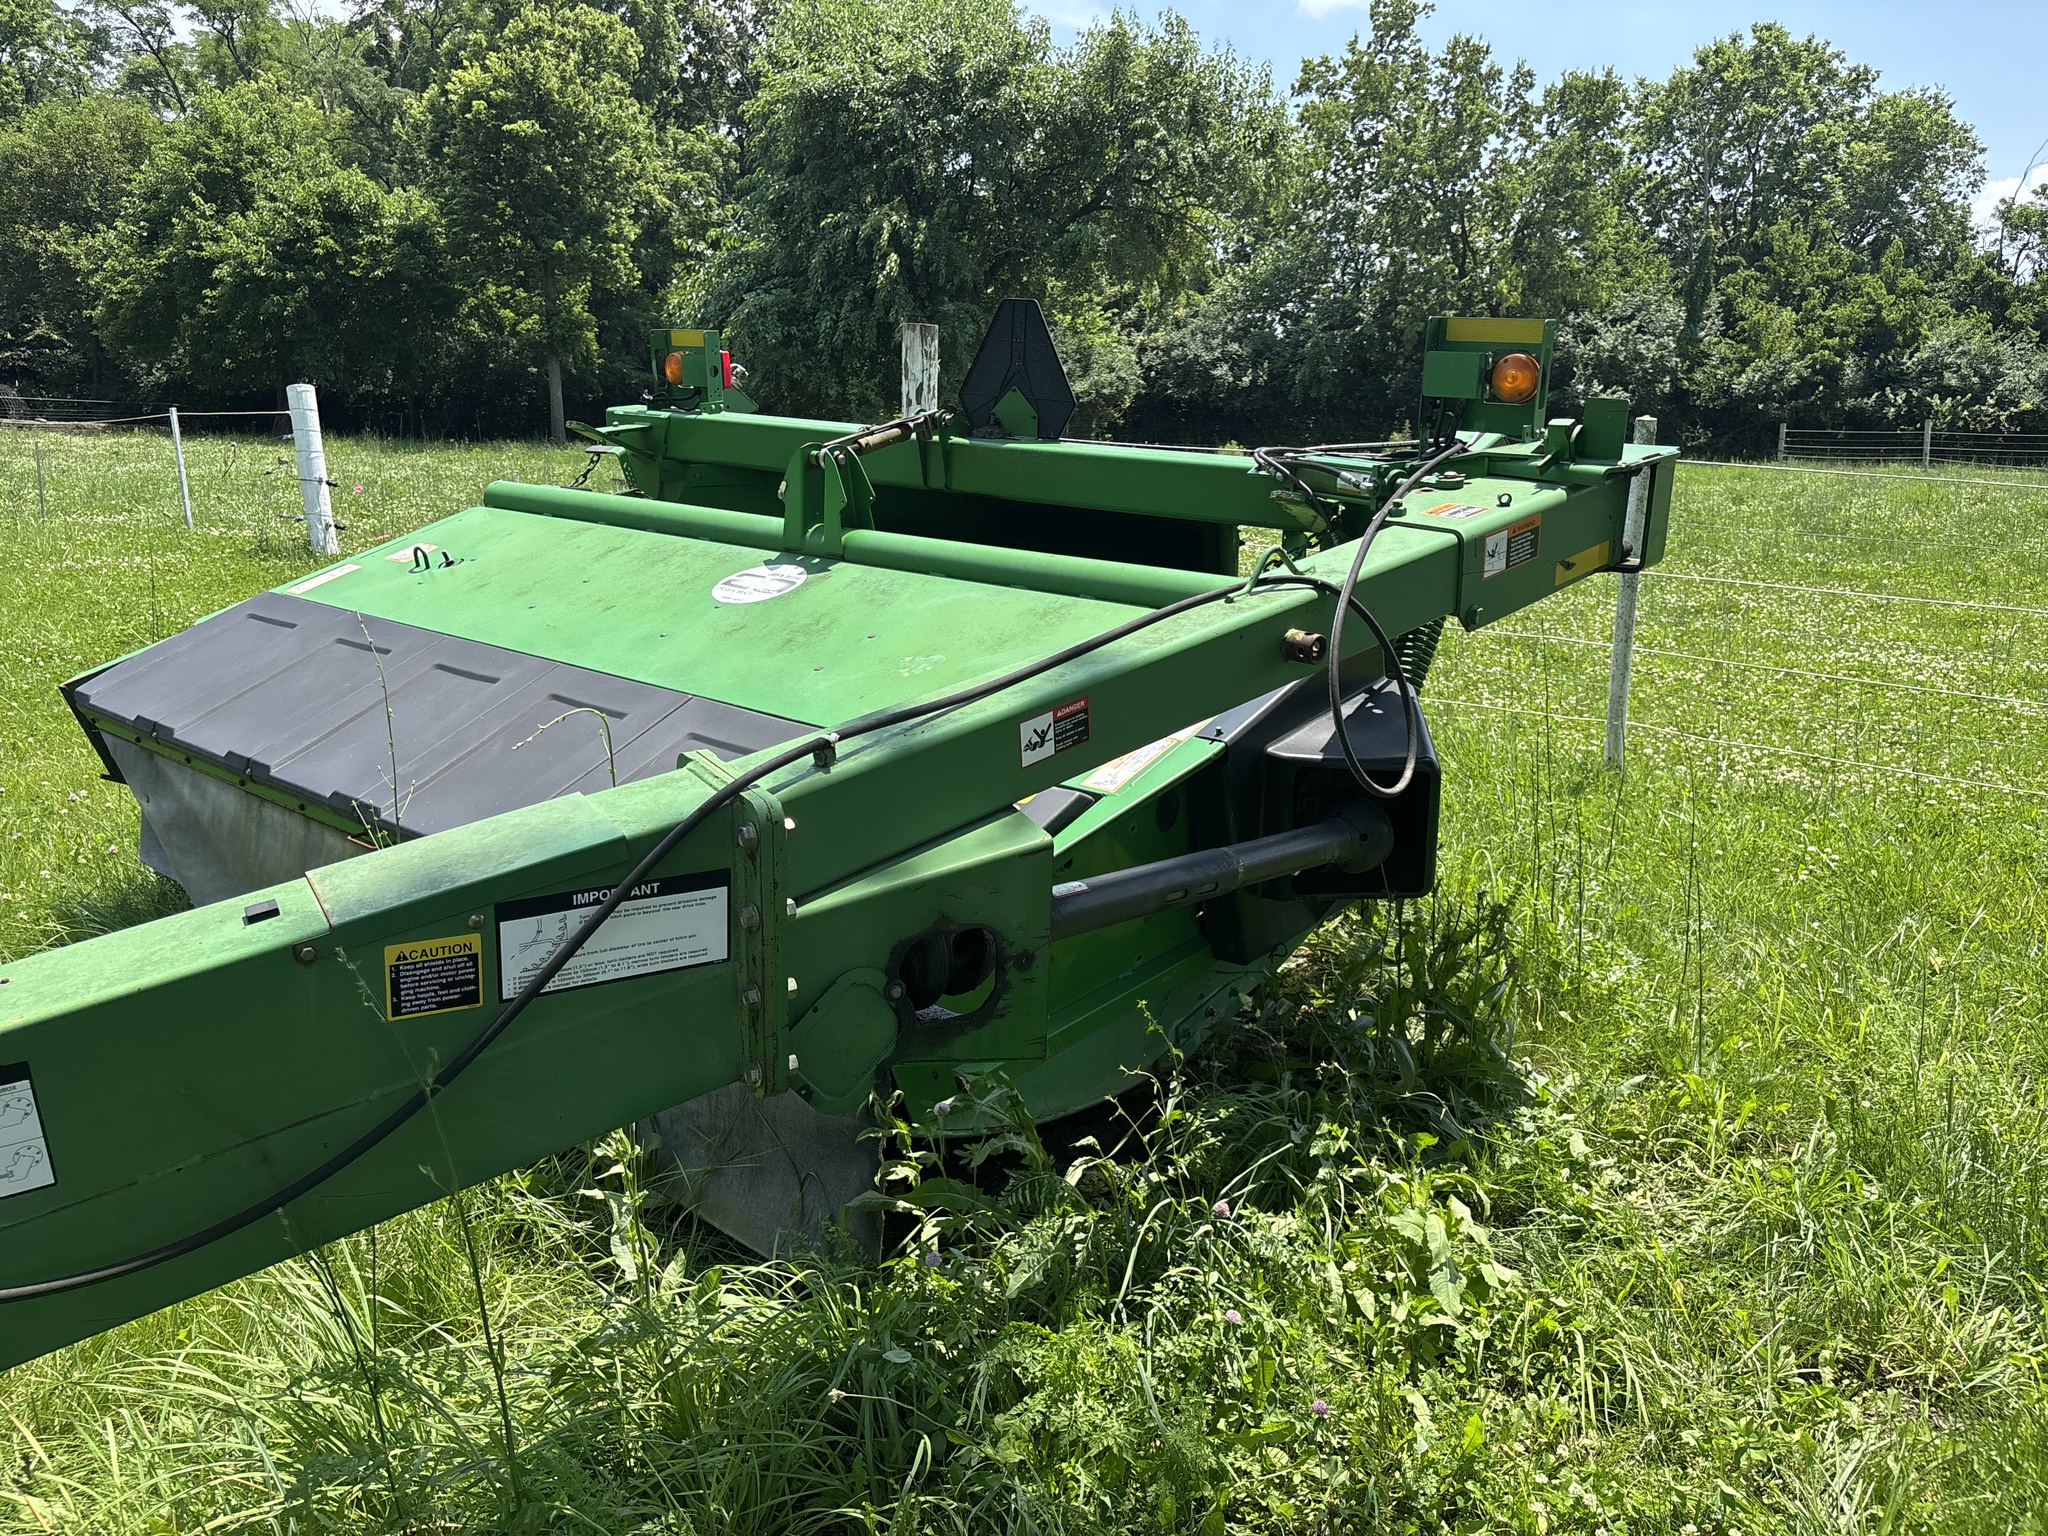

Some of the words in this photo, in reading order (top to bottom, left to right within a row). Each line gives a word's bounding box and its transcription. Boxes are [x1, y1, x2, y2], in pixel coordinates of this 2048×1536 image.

[1060, 700, 1085, 715] DANGER
[573, 883, 660, 905] IMPOANT
[409, 942, 472, 960] CAUTION
[453, 956, 469, 964] place.
[400, 969, 430, 977] Disengage
[400, 975, 420, 983] engine
[421, 972, 439, 980] and/or
[420, 977, 446, 986] servicing
[454, 973, 476, 981] unclog-
